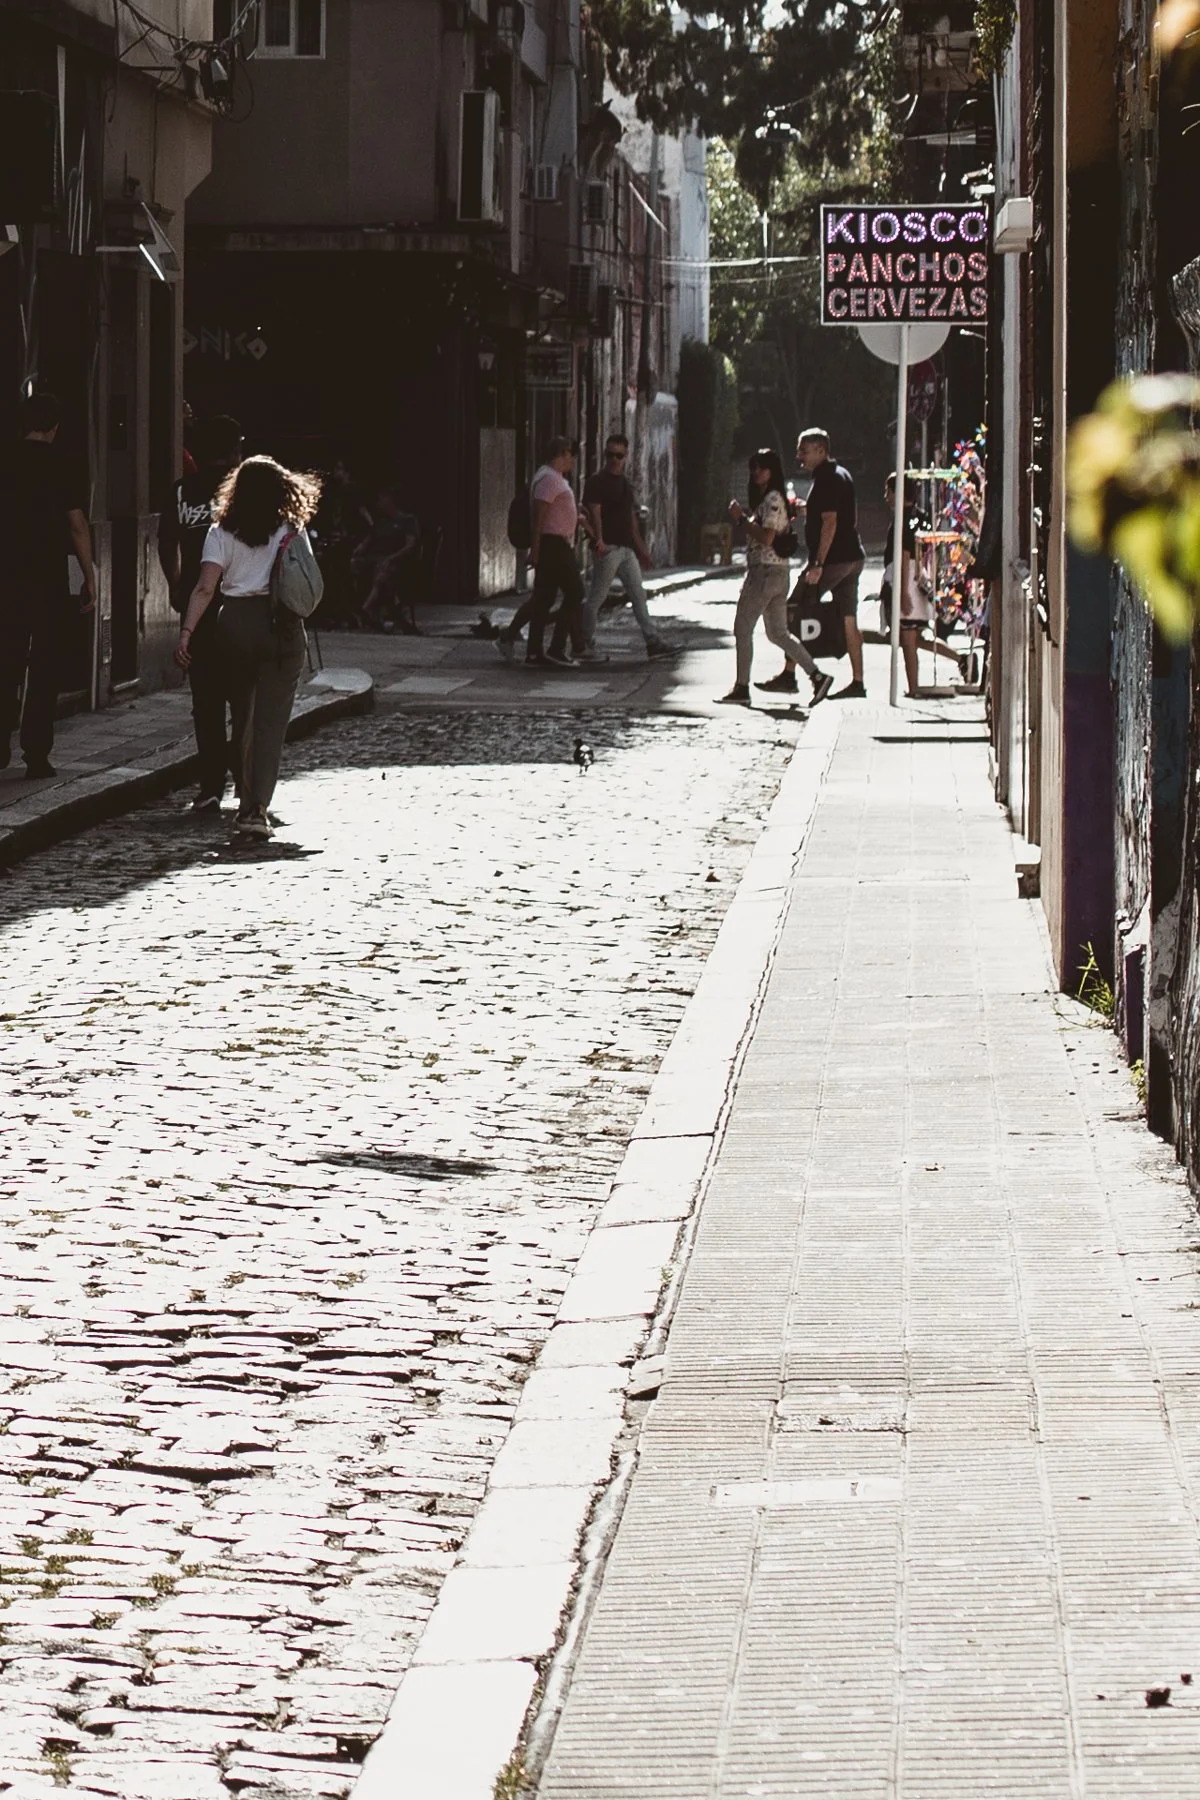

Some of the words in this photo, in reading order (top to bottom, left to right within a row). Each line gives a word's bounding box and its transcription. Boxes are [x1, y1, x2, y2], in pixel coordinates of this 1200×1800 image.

[826, 211, 988, 244] KIOSCO
[826, 252, 989, 283] PANCHOS
[827, 287, 989, 318] CERVEZAS
